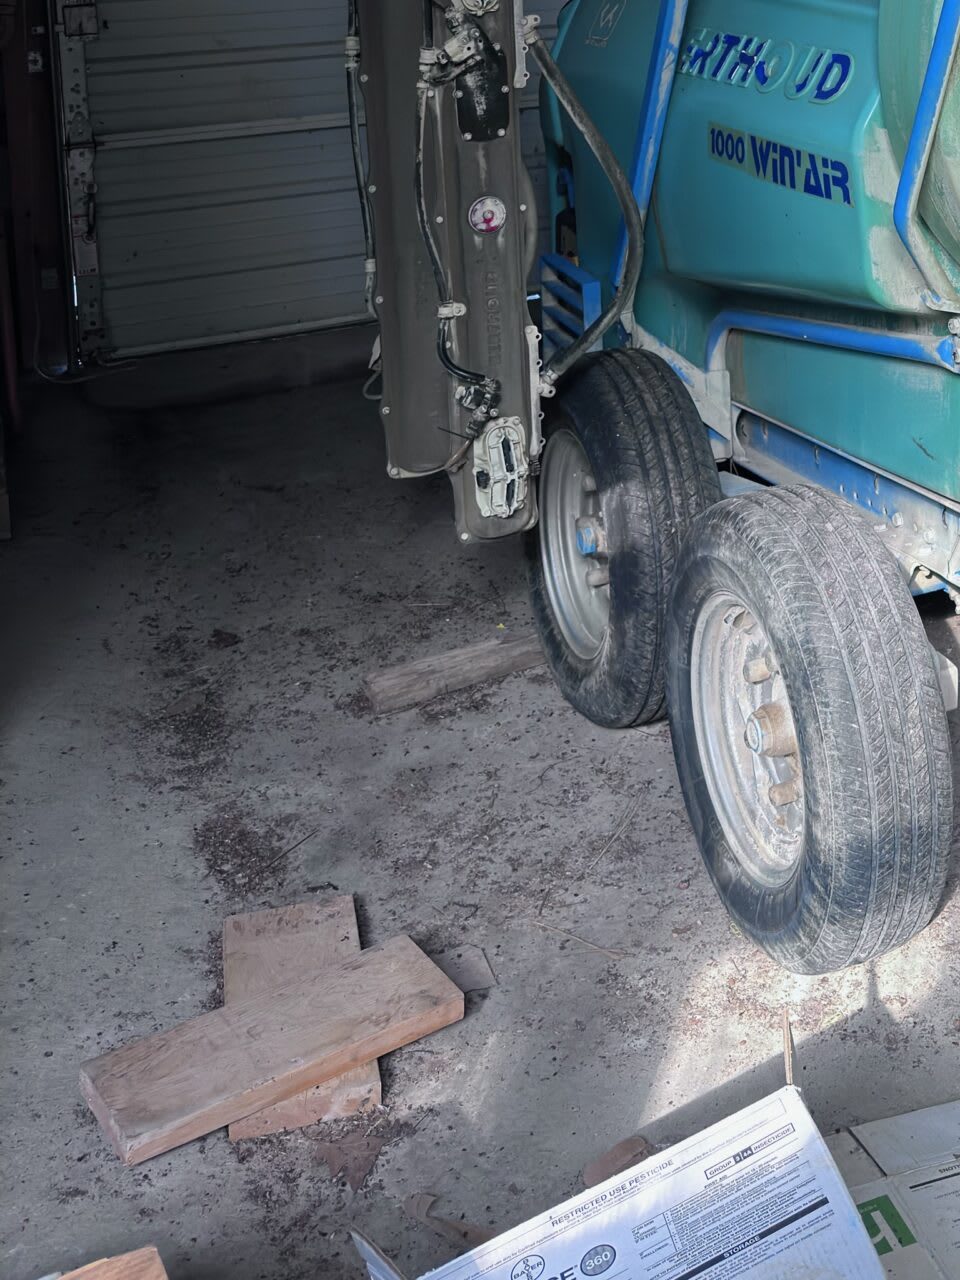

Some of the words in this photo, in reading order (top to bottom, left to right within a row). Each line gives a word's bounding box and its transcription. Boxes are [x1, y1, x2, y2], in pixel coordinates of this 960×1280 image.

[710, 127, 746, 164] 1000
[708, 1160, 732, 1175] GROUP
[742, 1148, 752, 1157] 4A
[752, 1126, 793, 1151] INSECTICIDE
[550, 1196, 608, 1226] RESTRICTED
[608, 1183, 627, 1197] USE
[627, 1158, 674, 1186] PESTICIDE
[583, 1250, 612, 1270] 360
[722, 1235, 761, 1258] STORAGE
